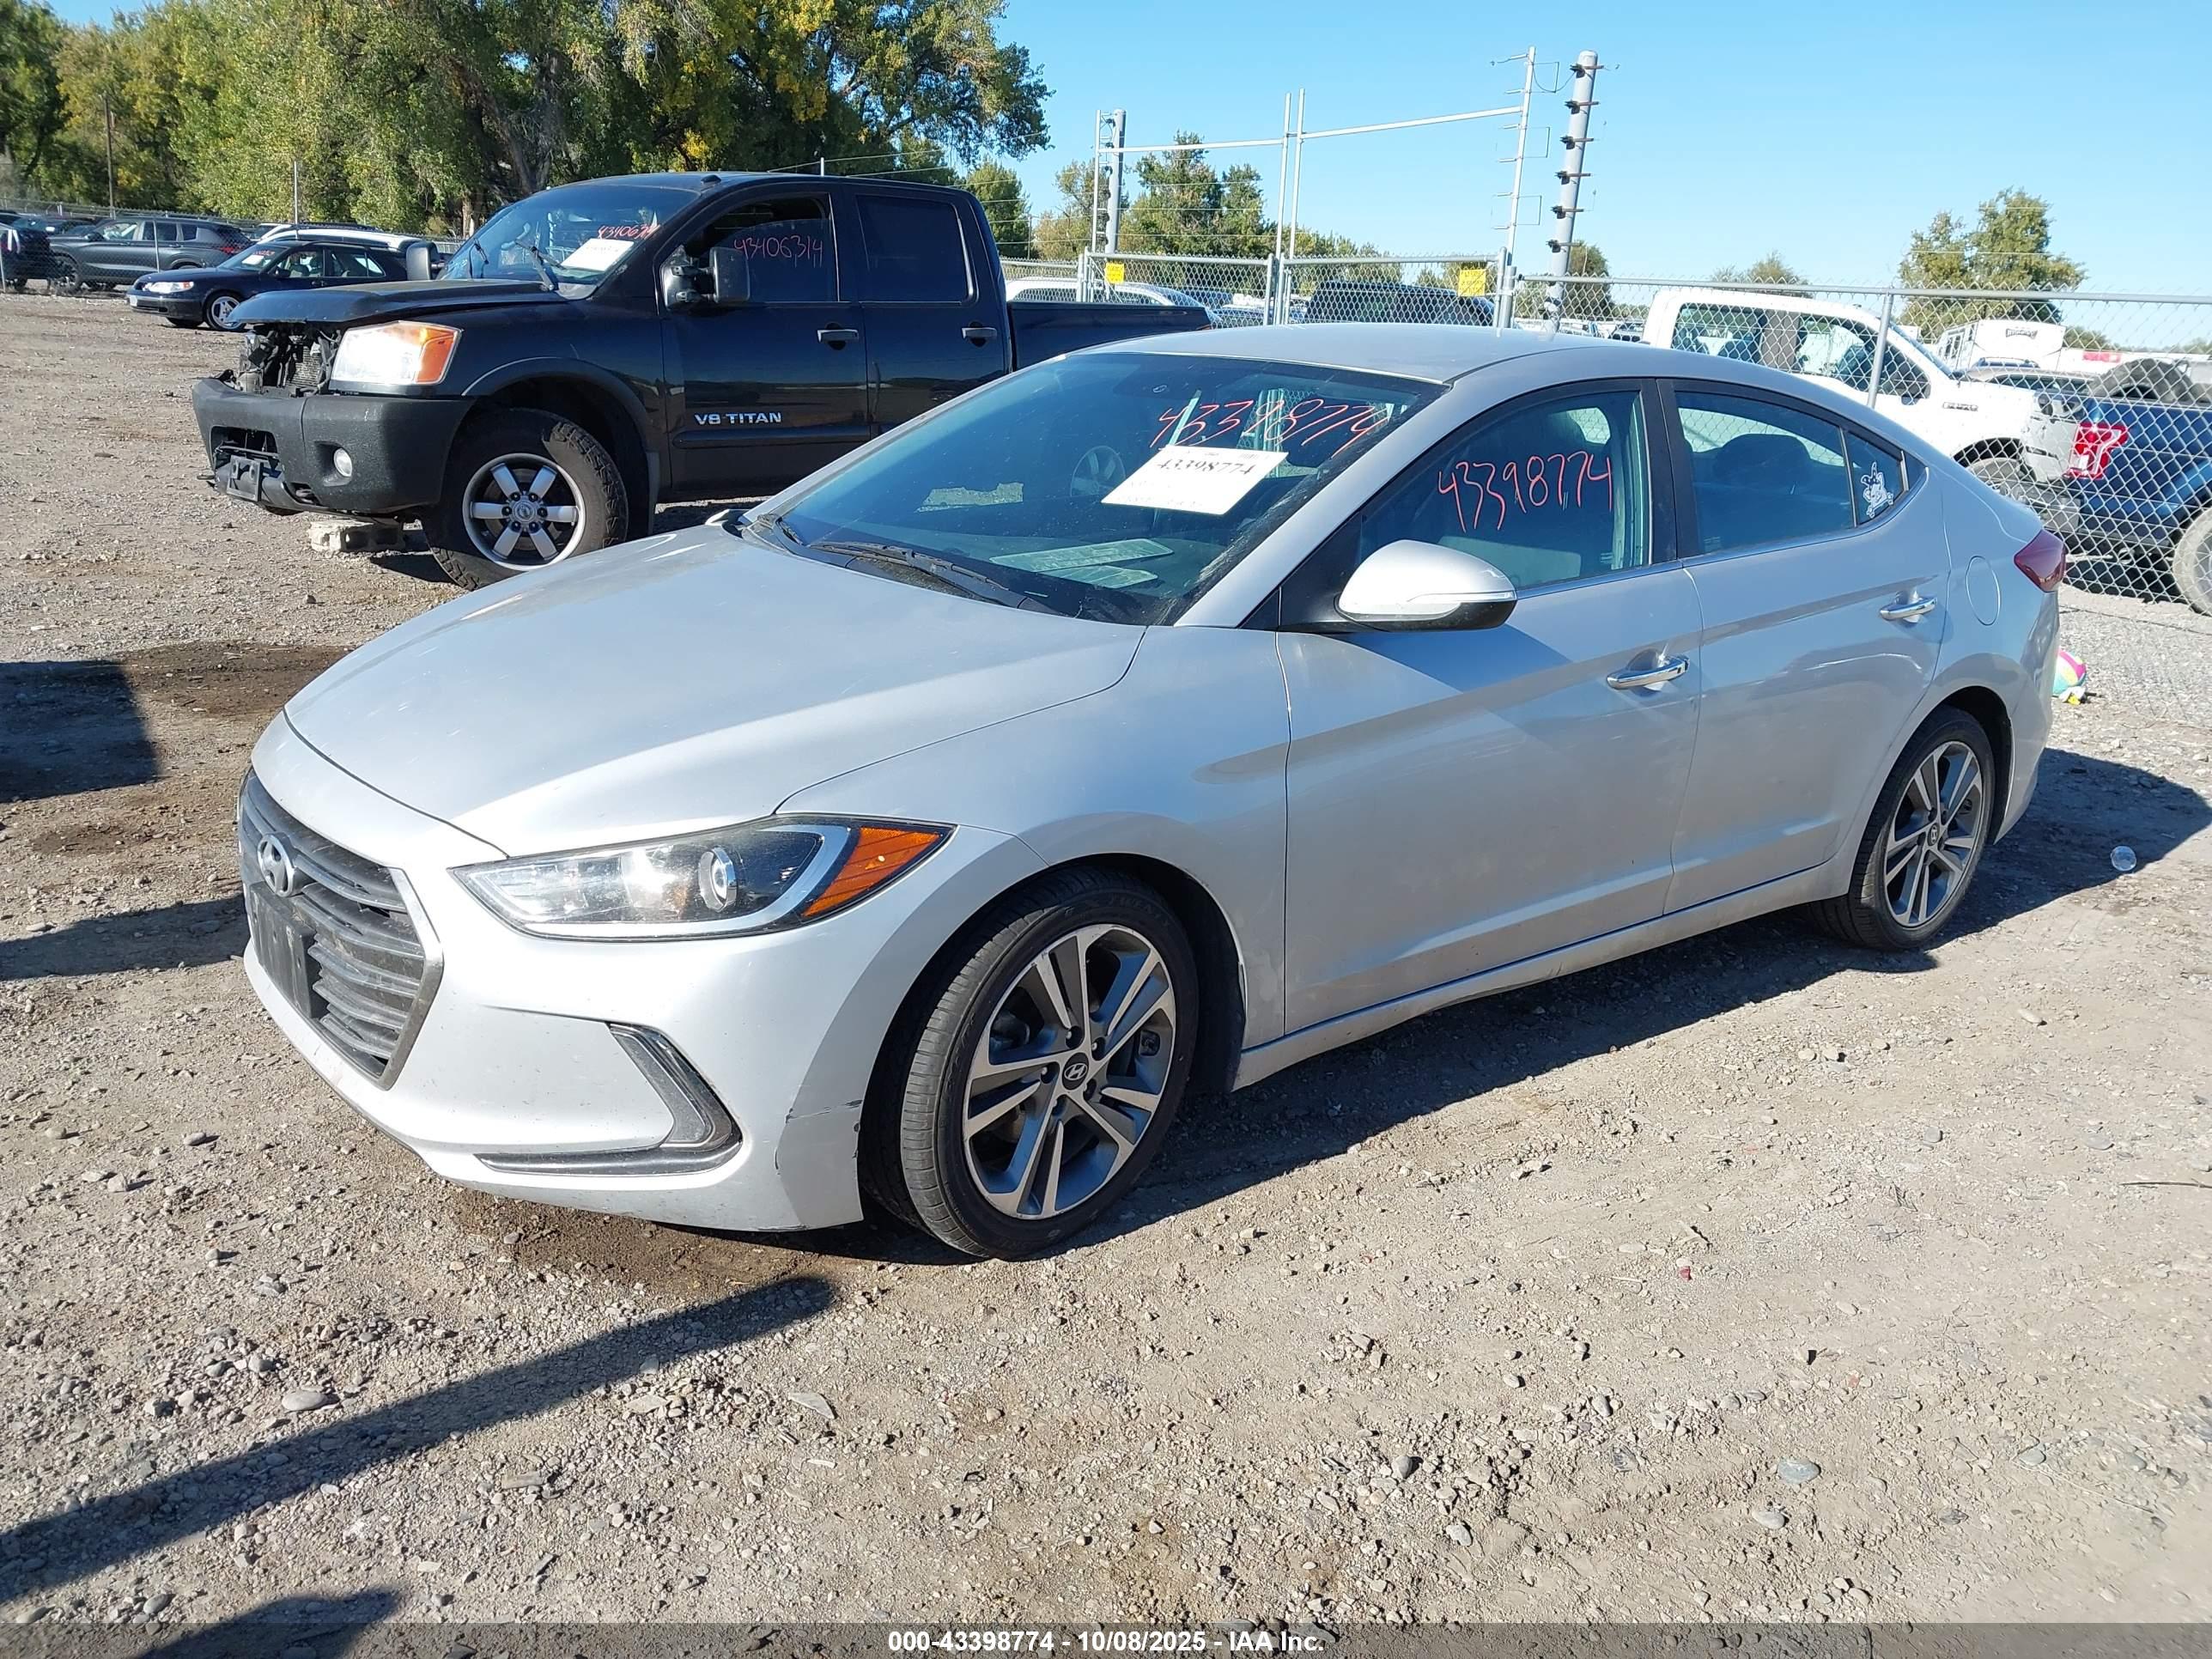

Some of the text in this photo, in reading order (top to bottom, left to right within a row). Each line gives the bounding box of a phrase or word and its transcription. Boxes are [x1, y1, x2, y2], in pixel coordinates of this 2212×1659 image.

[733, 234, 823, 264] 43406314
[694, 411, 781, 425] V8 TITAN
[1149, 398, 1390, 459] 43398774
[1158, 459, 1256, 475] 43398774
[1437, 451, 1613, 533] 43398774
